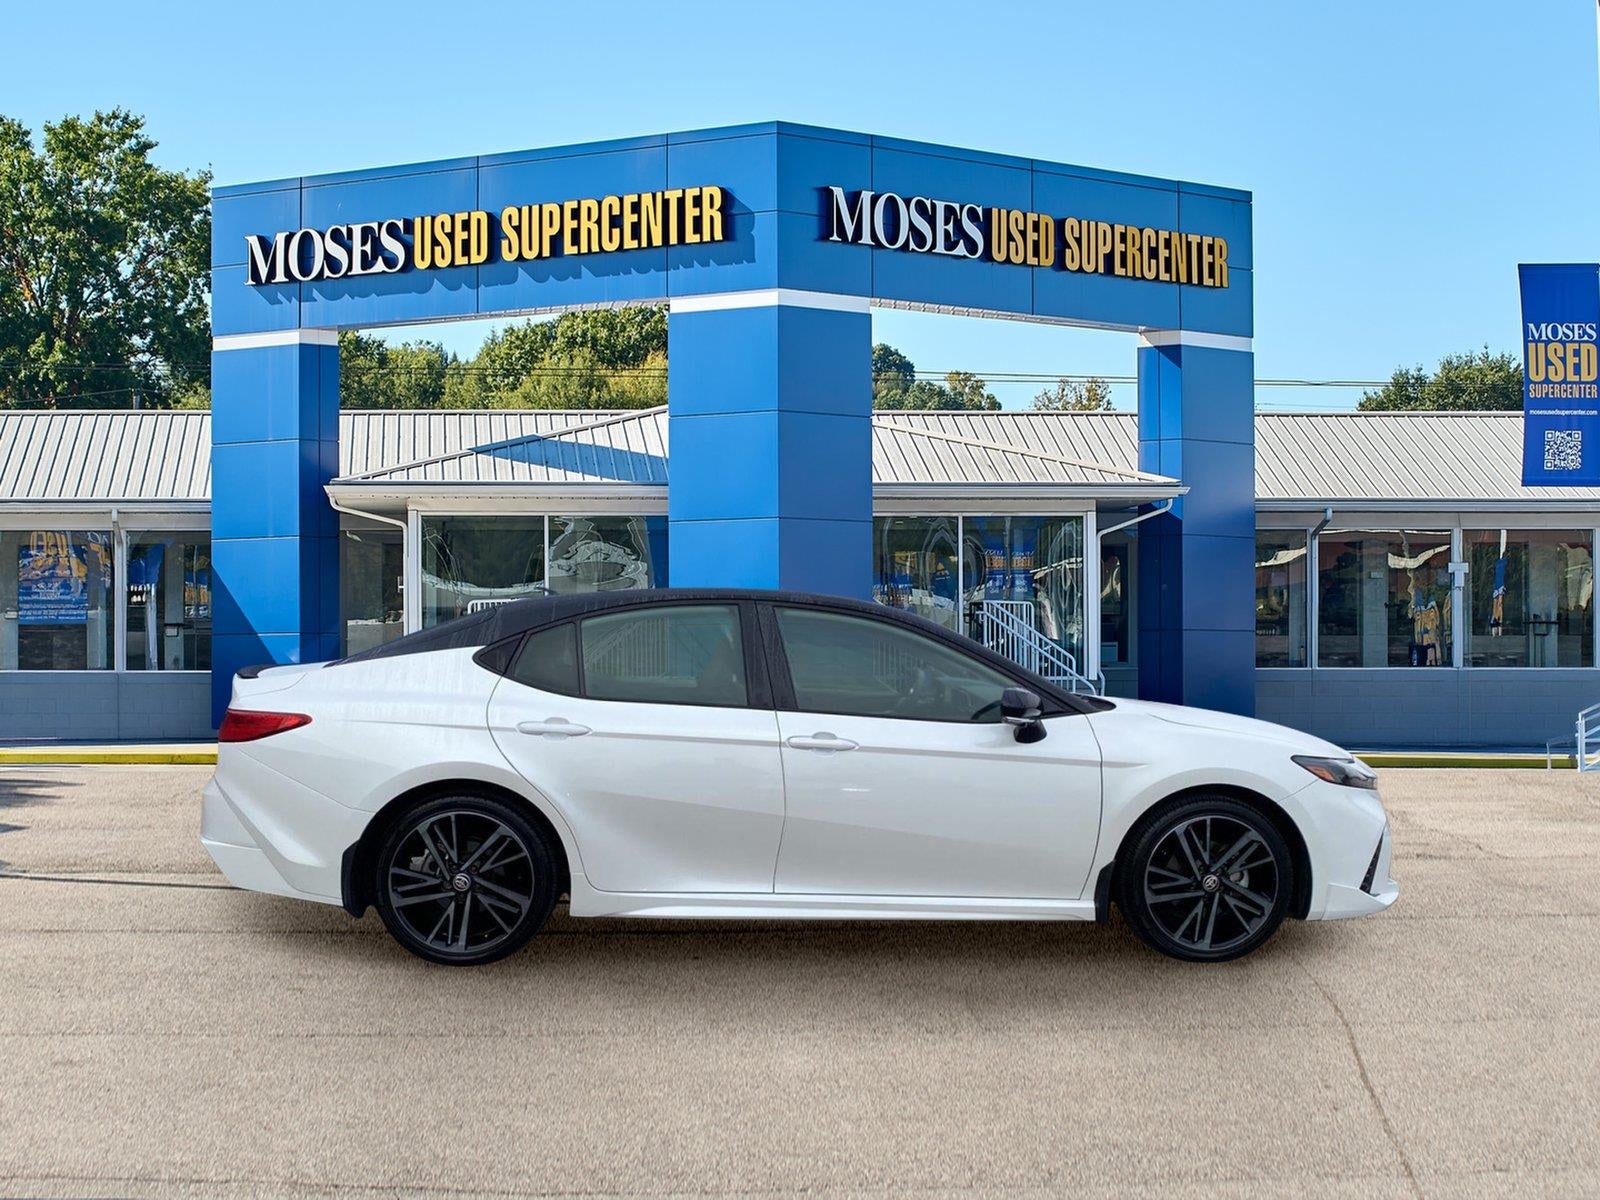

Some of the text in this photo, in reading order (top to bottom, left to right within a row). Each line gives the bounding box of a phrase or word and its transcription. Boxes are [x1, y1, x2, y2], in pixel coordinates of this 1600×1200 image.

[244, 185, 723, 286] MOSES USED SUPERCENTER
[829, 185, 1229, 288] MOSES USED SUPERCENTER
[1527, 322, 1597, 341] MOSES
[1528, 342, 1598, 382] USED
[1529, 384, 1598, 399] SUPERCENTER
[1529, 409, 1598, 417] mosesusedsupercenter.com
